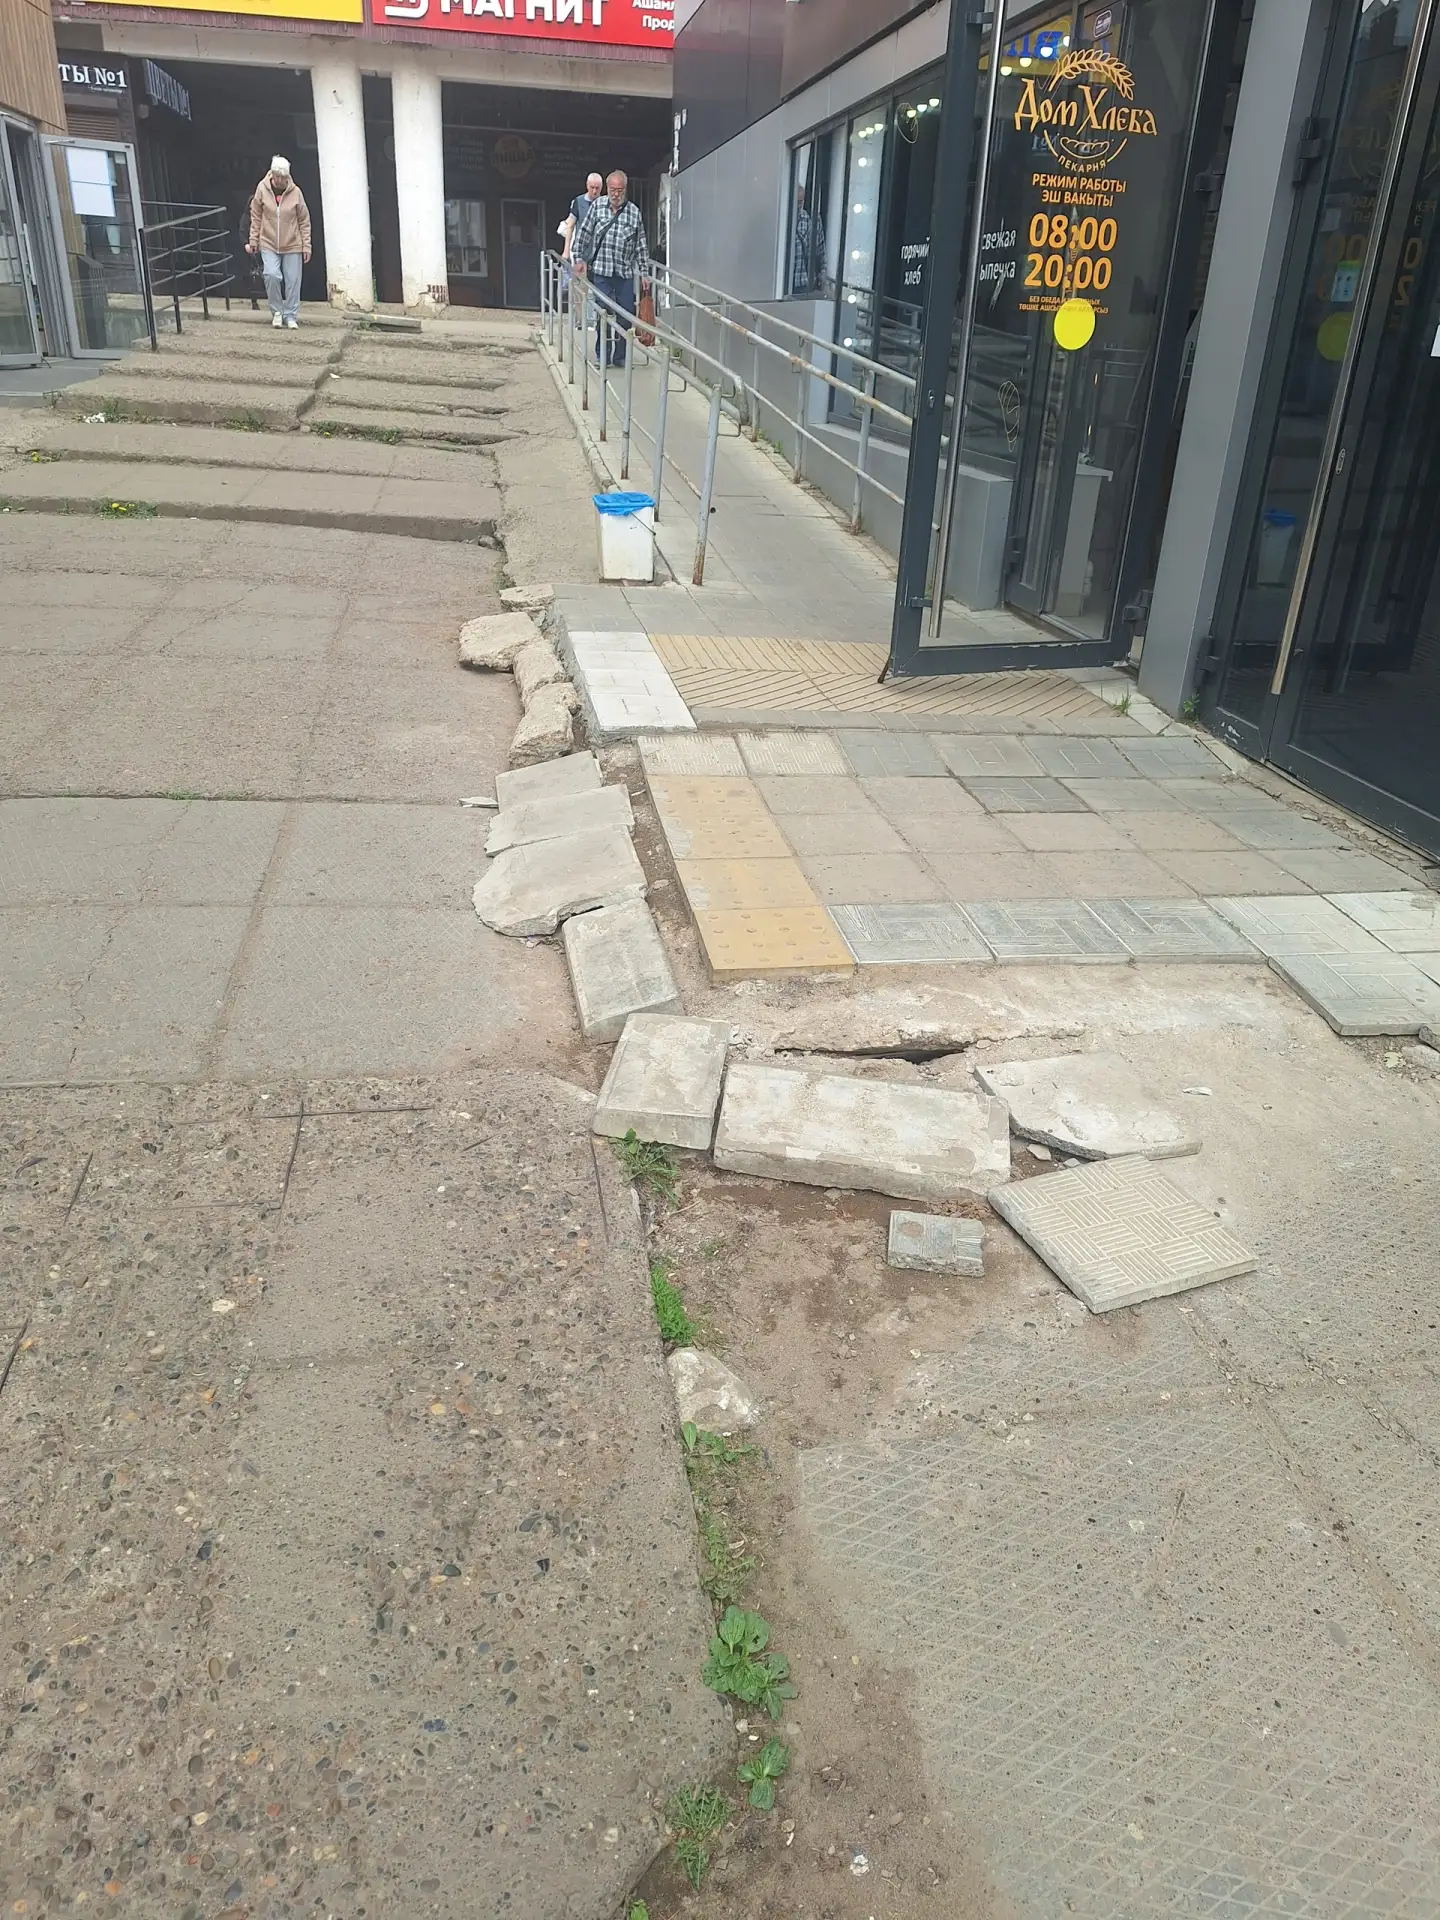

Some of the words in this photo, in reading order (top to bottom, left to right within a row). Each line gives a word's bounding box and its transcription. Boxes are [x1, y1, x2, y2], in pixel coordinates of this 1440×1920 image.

[93, 67, 127, 88] №1
[1058, 155, 1106, 173] ПЕКАРНЯ
[1032, 173, 1078, 189] РЕЖИМ
[1080, 177, 1127, 193] РАБОТЫ
[1042, 189, 1061, 204] ЭШ
[1064, 191, 1114, 207] ВАКЫТЫ
[1029, 212, 1118, 251] 08:00
[904, 263, 921, 285] хлеб
[1024, 253, 1112, 290] 20:00
[1029, 295, 1040, 303] БЕЗ
